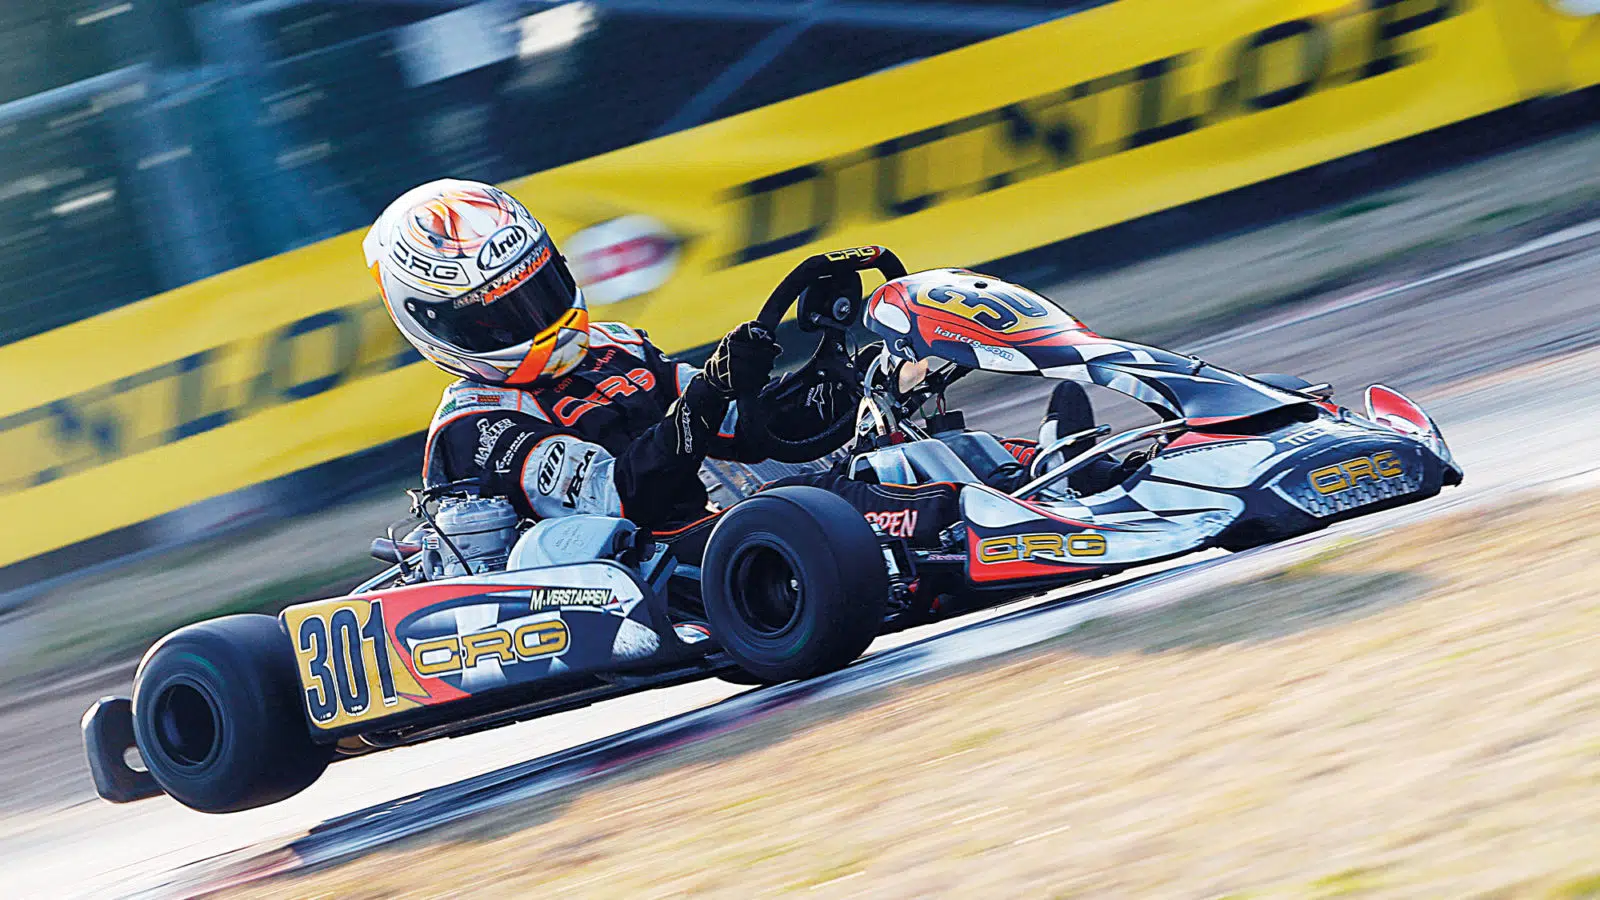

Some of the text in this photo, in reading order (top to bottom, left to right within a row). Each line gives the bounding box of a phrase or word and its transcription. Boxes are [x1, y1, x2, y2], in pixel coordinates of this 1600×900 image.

[393, 241, 459, 280] CRG
[483, 228, 522, 269] Arai
[824, 247, 876, 262] CRG
[933, 325, 1015, 362] kartcrg.com
[1307, 450, 1404, 496] CRG
[978, 532, 1107, 564] CRG
[298, 598, 399, 724] 301
[411, 618, 571, 678] CRG
